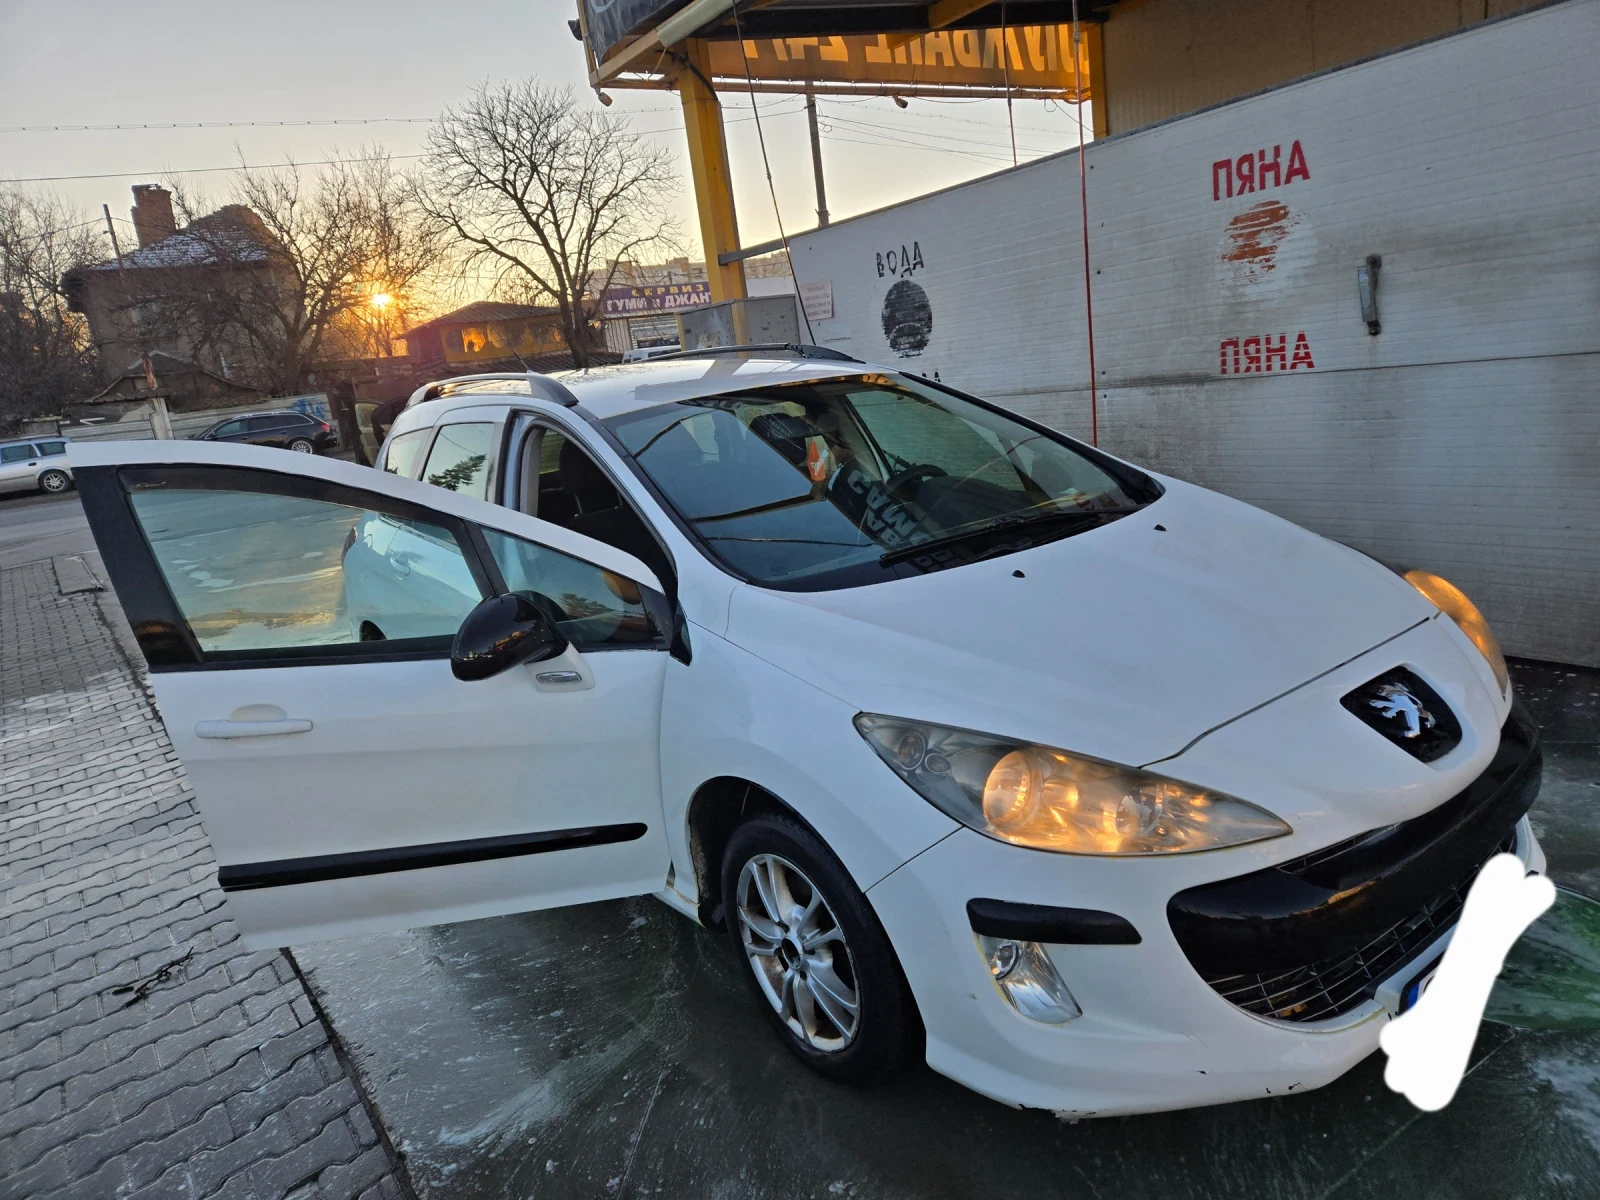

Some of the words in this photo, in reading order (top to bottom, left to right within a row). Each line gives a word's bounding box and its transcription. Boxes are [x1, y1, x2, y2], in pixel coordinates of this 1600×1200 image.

[1212, 140, 1310, 201] ПЯНА
[876, 241, 924, 278] ВОДА
[631, 284, 704, 296] СЕРВИЗ
[664, 292, 711, 308] ДЖАН
[1221, 331, 1315, 375] ПЯНА
